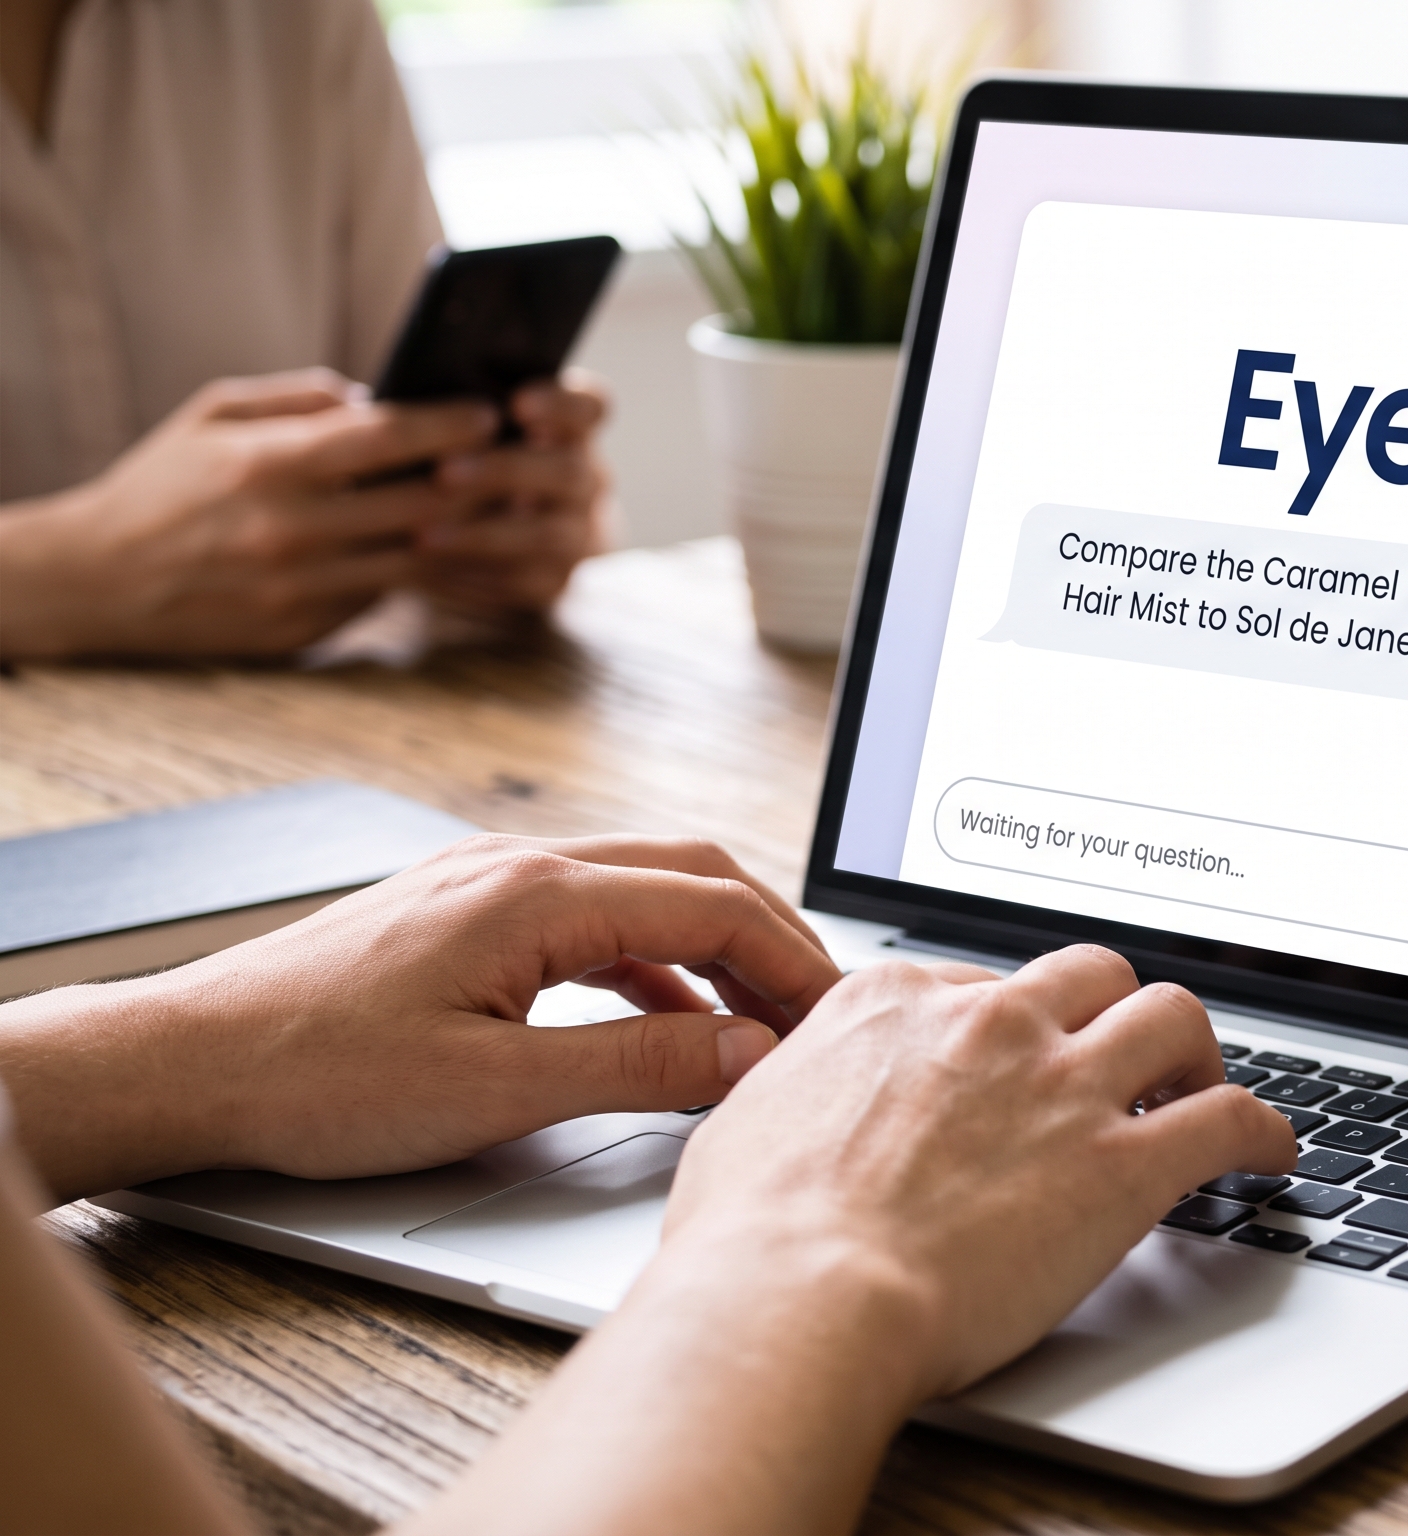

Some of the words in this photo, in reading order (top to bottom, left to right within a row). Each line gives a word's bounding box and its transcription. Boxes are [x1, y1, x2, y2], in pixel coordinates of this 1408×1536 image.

[1059, 532, 1197, 577] Compare
[1207, 549, 1254, 582] the
[1263, 557, 1400, 600] Caramel
[1062, 582, 1122, 617] Hair
[1129, 591, 1190, 626] Mist
[1198, 600, 1227, 631] to
[1235, 605, 1282, 639] Sol
[1289, 611, 1329, 645] de
[961, 808, 1041, 850] Waiting
[1046, 822, 1076, 848] for
[1080, 833, 1130, 858] your
[1134, 843, 1245, 878] question...
